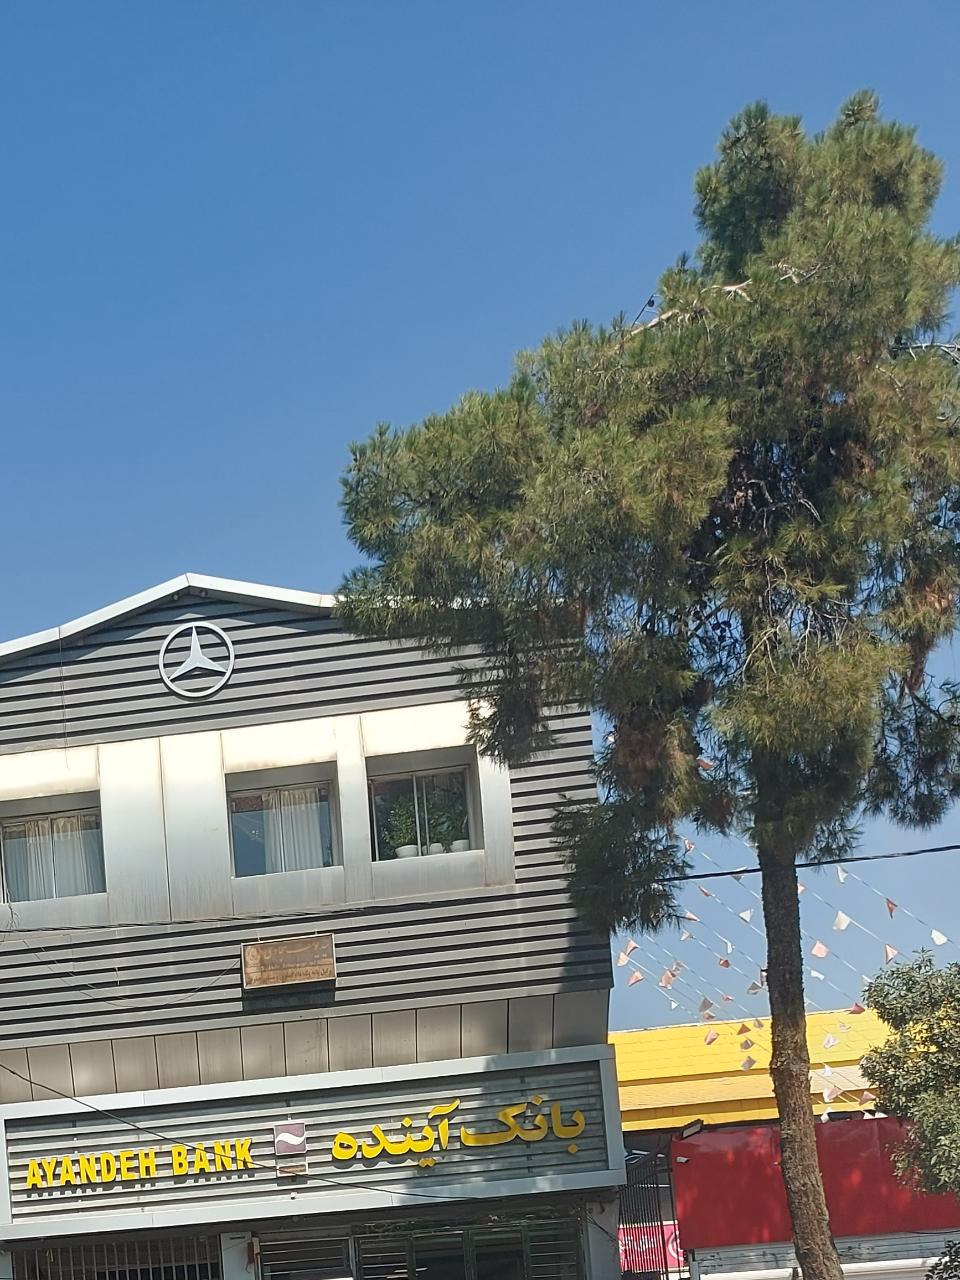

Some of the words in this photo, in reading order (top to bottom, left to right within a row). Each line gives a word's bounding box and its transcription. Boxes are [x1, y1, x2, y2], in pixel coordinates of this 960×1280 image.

[331, 1099, 460, 1168] آینده
[460, 1095, 586, 1156] بانک
[26, 1148, 156, 1188] AYANDEH
[171, 1139, 255, 1176] BANK
